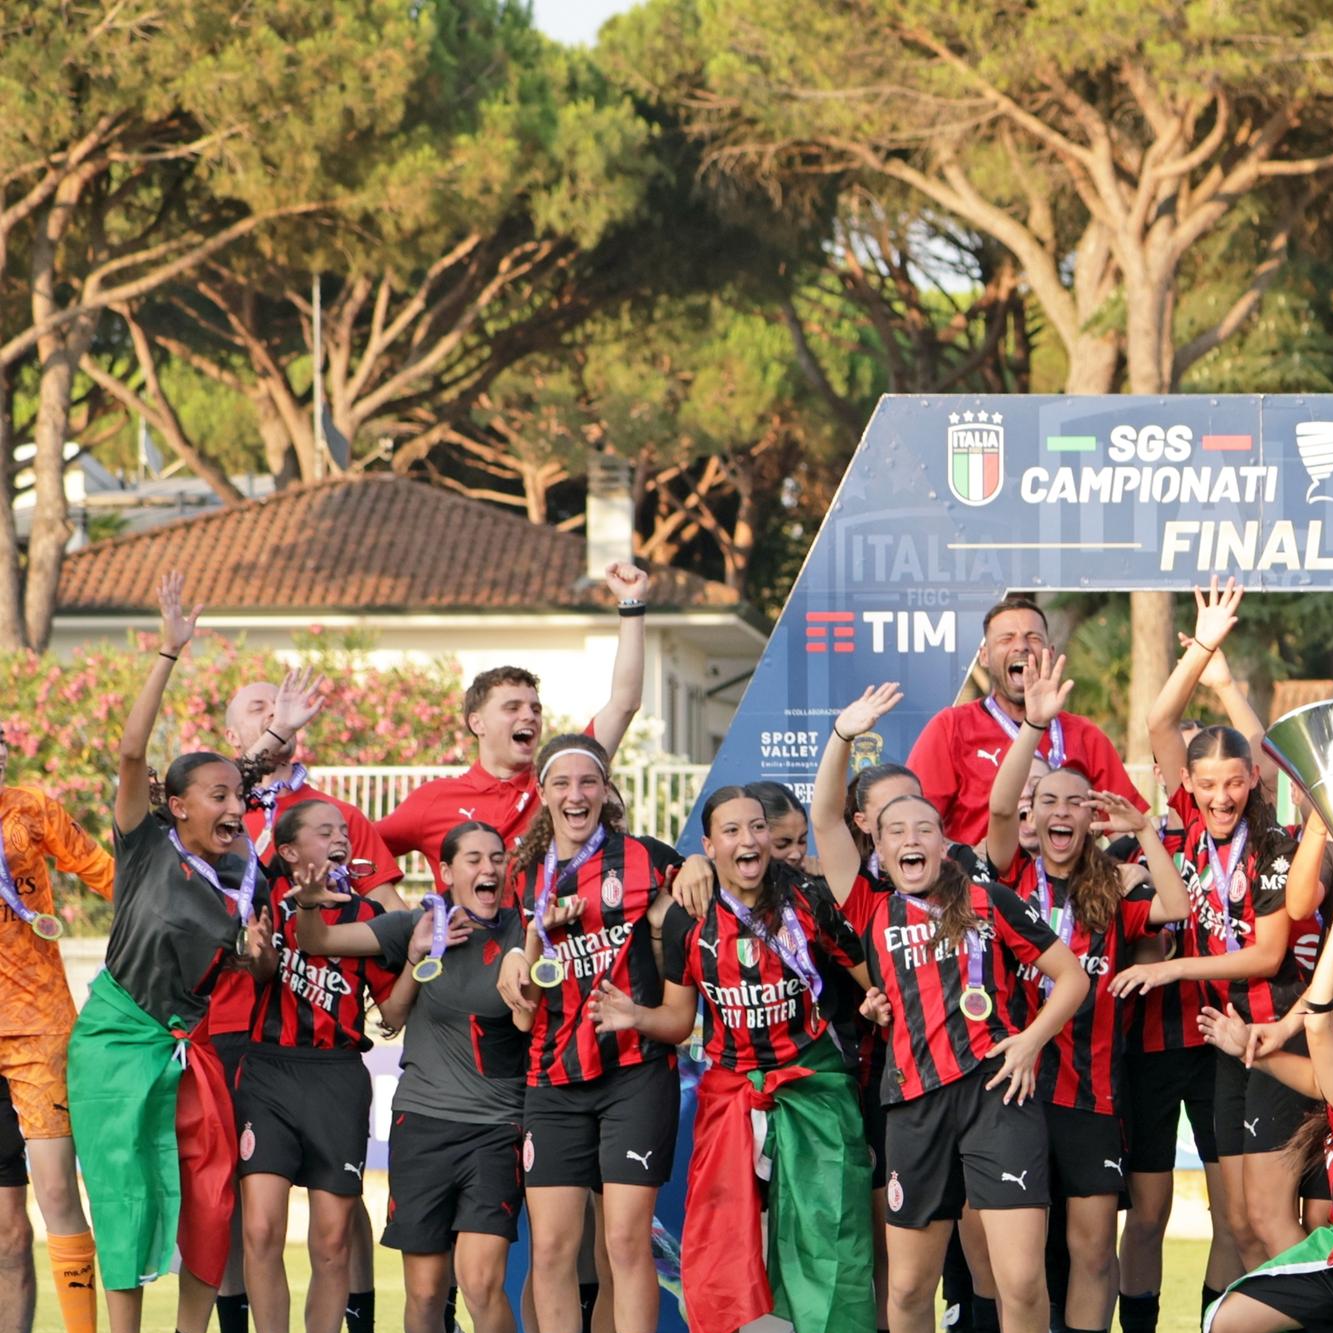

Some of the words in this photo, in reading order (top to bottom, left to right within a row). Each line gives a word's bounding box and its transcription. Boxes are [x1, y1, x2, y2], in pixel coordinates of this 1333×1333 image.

[952, 430, 999, 448] ITALIA
[1108, 424, 1193, 463] SGS
[1020, 466, 1278, 504] CAMPIONATI
[852, 534, 1005, 583] ITALIA
[907, 587, 951, 606] FIGC
[863, 611, 956, 653] TIM
[761, 732, 818, 745] SPORT
[761, 746, 818, 757] VALLEY
[1260, 874, 1288, 890] MS
[574, 948, 620, 978] BETTE
[701, 978, 811, 1007] Emirates
[721, 1007, 743, 1029] FLY
[747, 999, 797, 1028] BETTER
